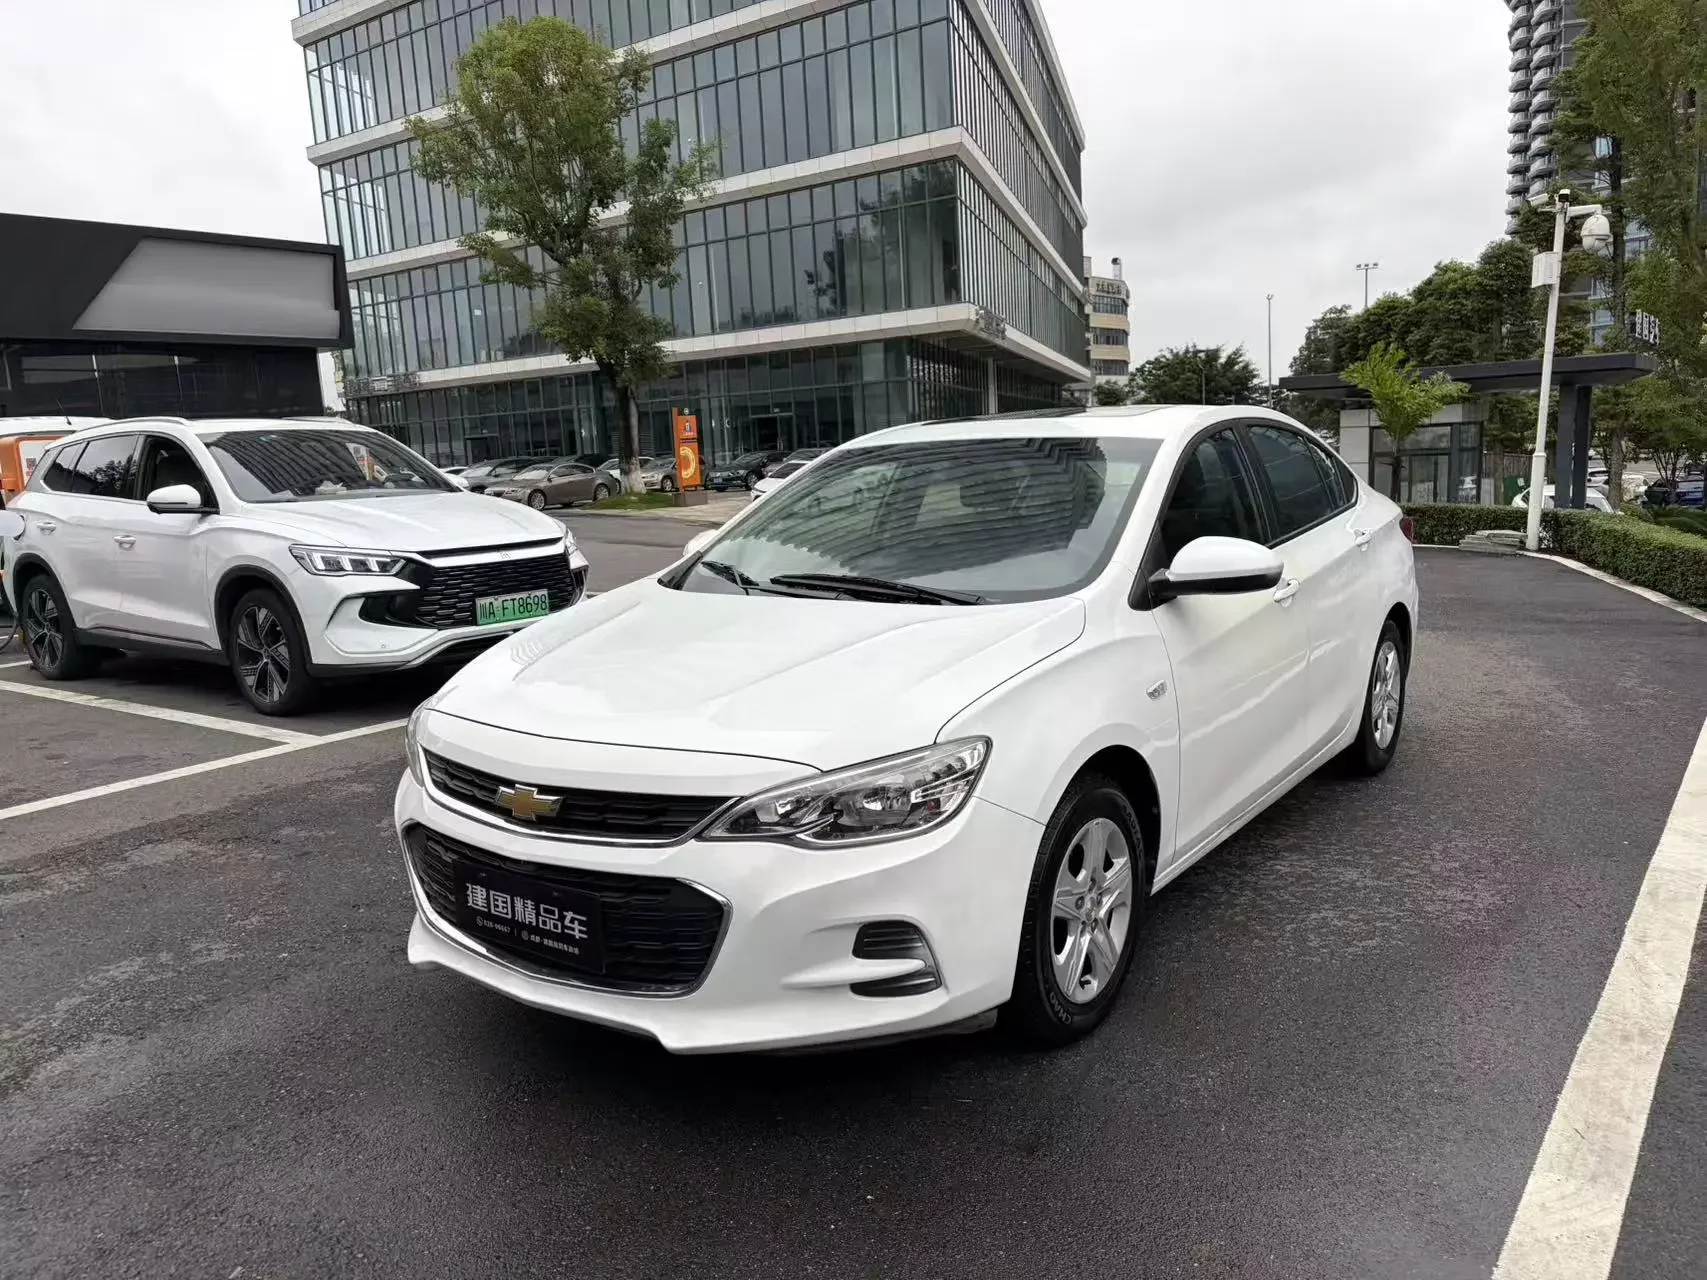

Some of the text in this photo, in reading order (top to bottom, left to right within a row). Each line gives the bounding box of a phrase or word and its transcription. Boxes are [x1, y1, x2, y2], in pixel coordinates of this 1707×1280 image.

[466, 883, 588, 940] 建国精品车
